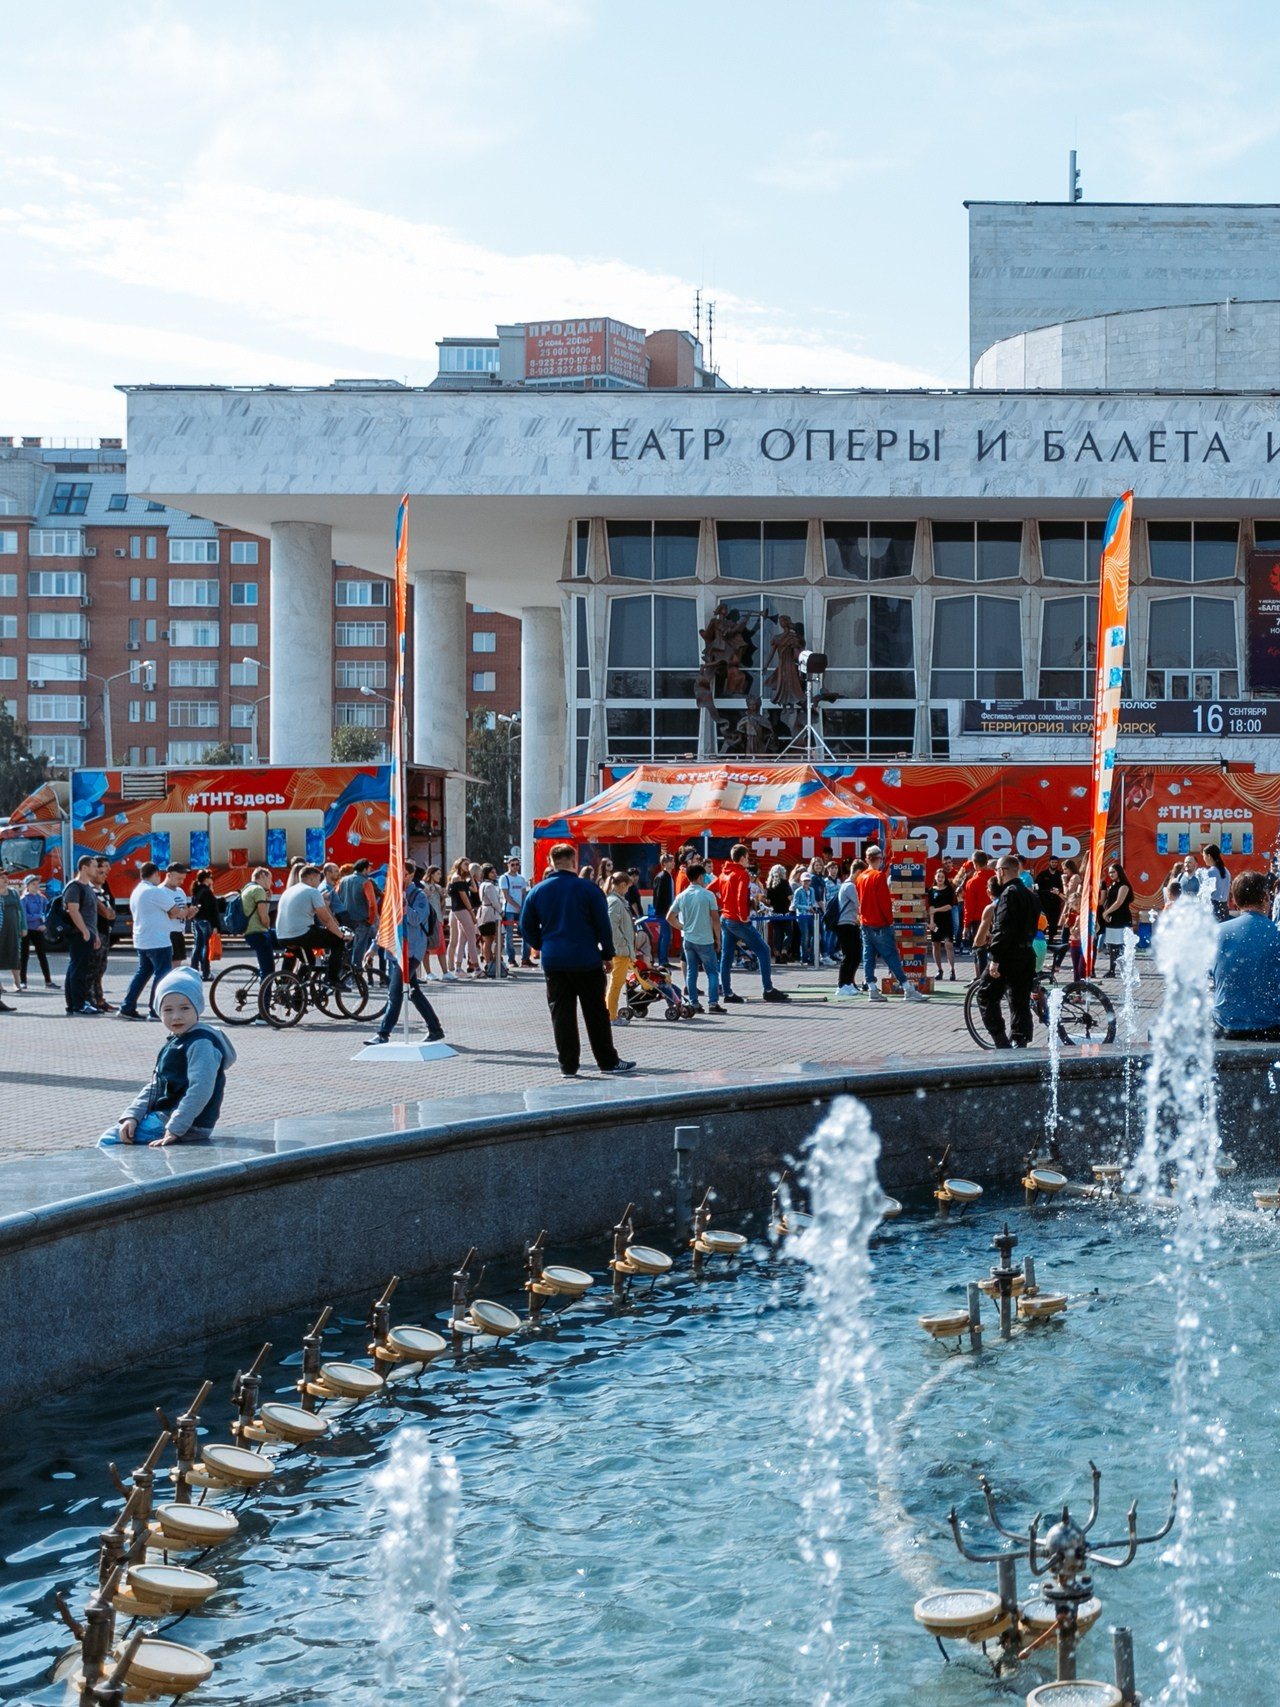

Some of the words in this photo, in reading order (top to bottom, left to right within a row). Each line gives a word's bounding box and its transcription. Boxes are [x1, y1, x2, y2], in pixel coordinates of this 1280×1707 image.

[529, 320, 603, 337] ПРОДАМ
[538, 339, 544, 347] 5
[540, 348, 551, 357] 25
[552, 347, 568, 356] 000
[577, 427, 726, 462] ТЕАТР
[760, 427, 941, 462] ОПЕРЫ
[976, 429, 1007, 462] И
[1043, 430, 1231, 463] БАЛЕТА
[980, 712, 1037, 721] Фестиваль-школа
[1038, 714, 1082, 722] современного
[1228, 707, 1267, 716] СЕНТЯБРЯ
[1193, 704, 1224, 733] 16
[980, 721, 1068, 734] ТЕРРИТОРИЯ.
[1072, 722, 1157, 734] КРАОЯРСК
[1229, 719, 1262, 732] 18:00
[676, 770, 768, 783] #ТНТздесь
[187, 791, 286, 807] #ТНТздесь
[1157, 805, 1254, 820] #ТНТздесь
[151, 808, 326, 871] ТНТ
[1156, 822, 1254, 855] ТНТ
[893, 863, 921, 871] ОСТРОВ
